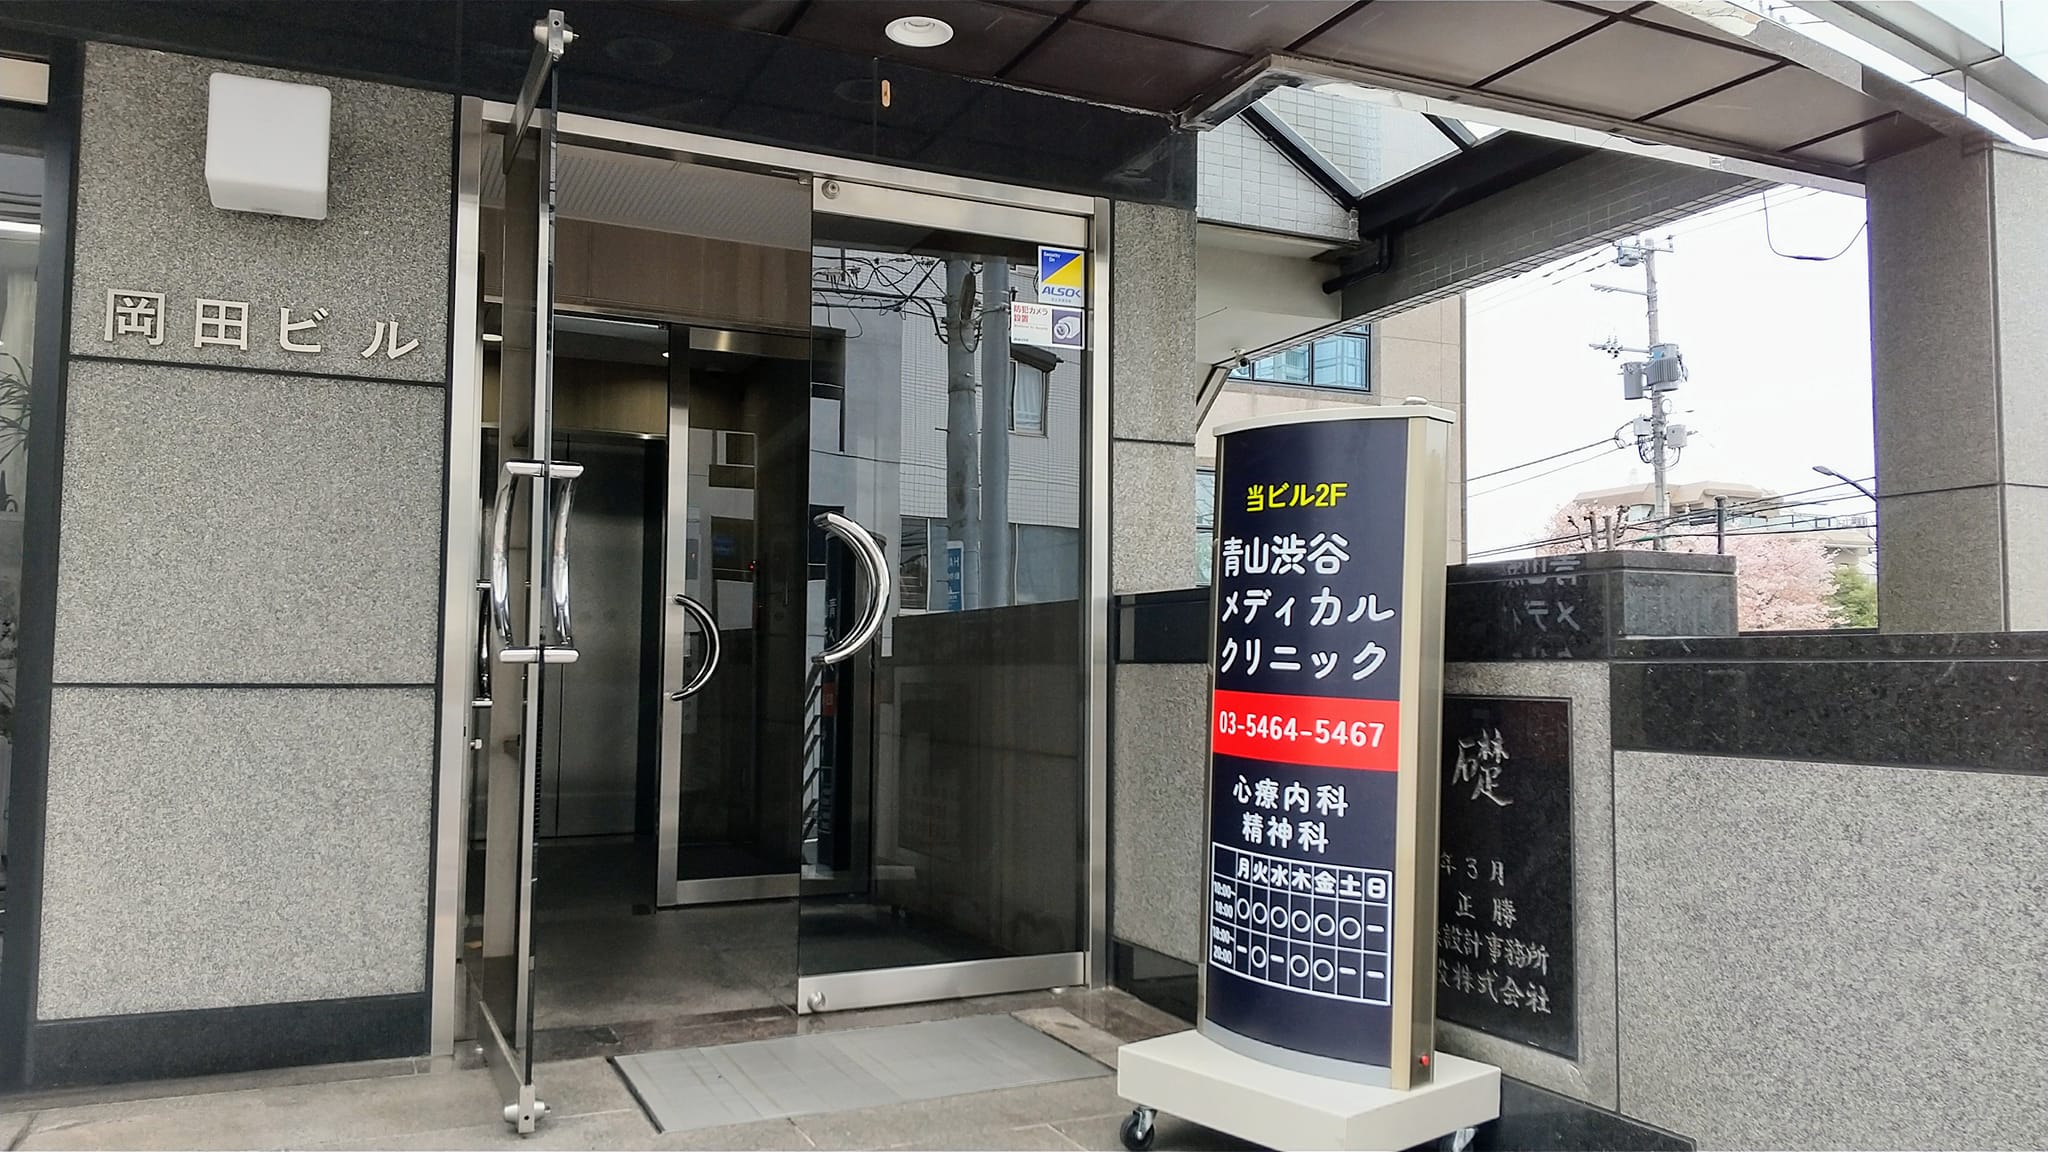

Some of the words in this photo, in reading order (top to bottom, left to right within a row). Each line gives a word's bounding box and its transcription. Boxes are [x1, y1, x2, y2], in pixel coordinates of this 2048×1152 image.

[1041, 286, 1081, 298] ALSOK
[103, 288, 420, 360] 岡田ビル
[1246, 482, 1349, 512] 当ビル2F
[1222, 533, 1351, 578] 青山渋谷
[1221, 586, 1396, 627] メディカル
[1220, 637, 1388, 681] クリニック
[1218, 710, 1386, 748] 03-5464-5467
[1232, 774, 1350, 818] 心療内科
[1241, 811, 1330, 854] 精神科
[1437, 922, 1551, 976] 設計事務所
